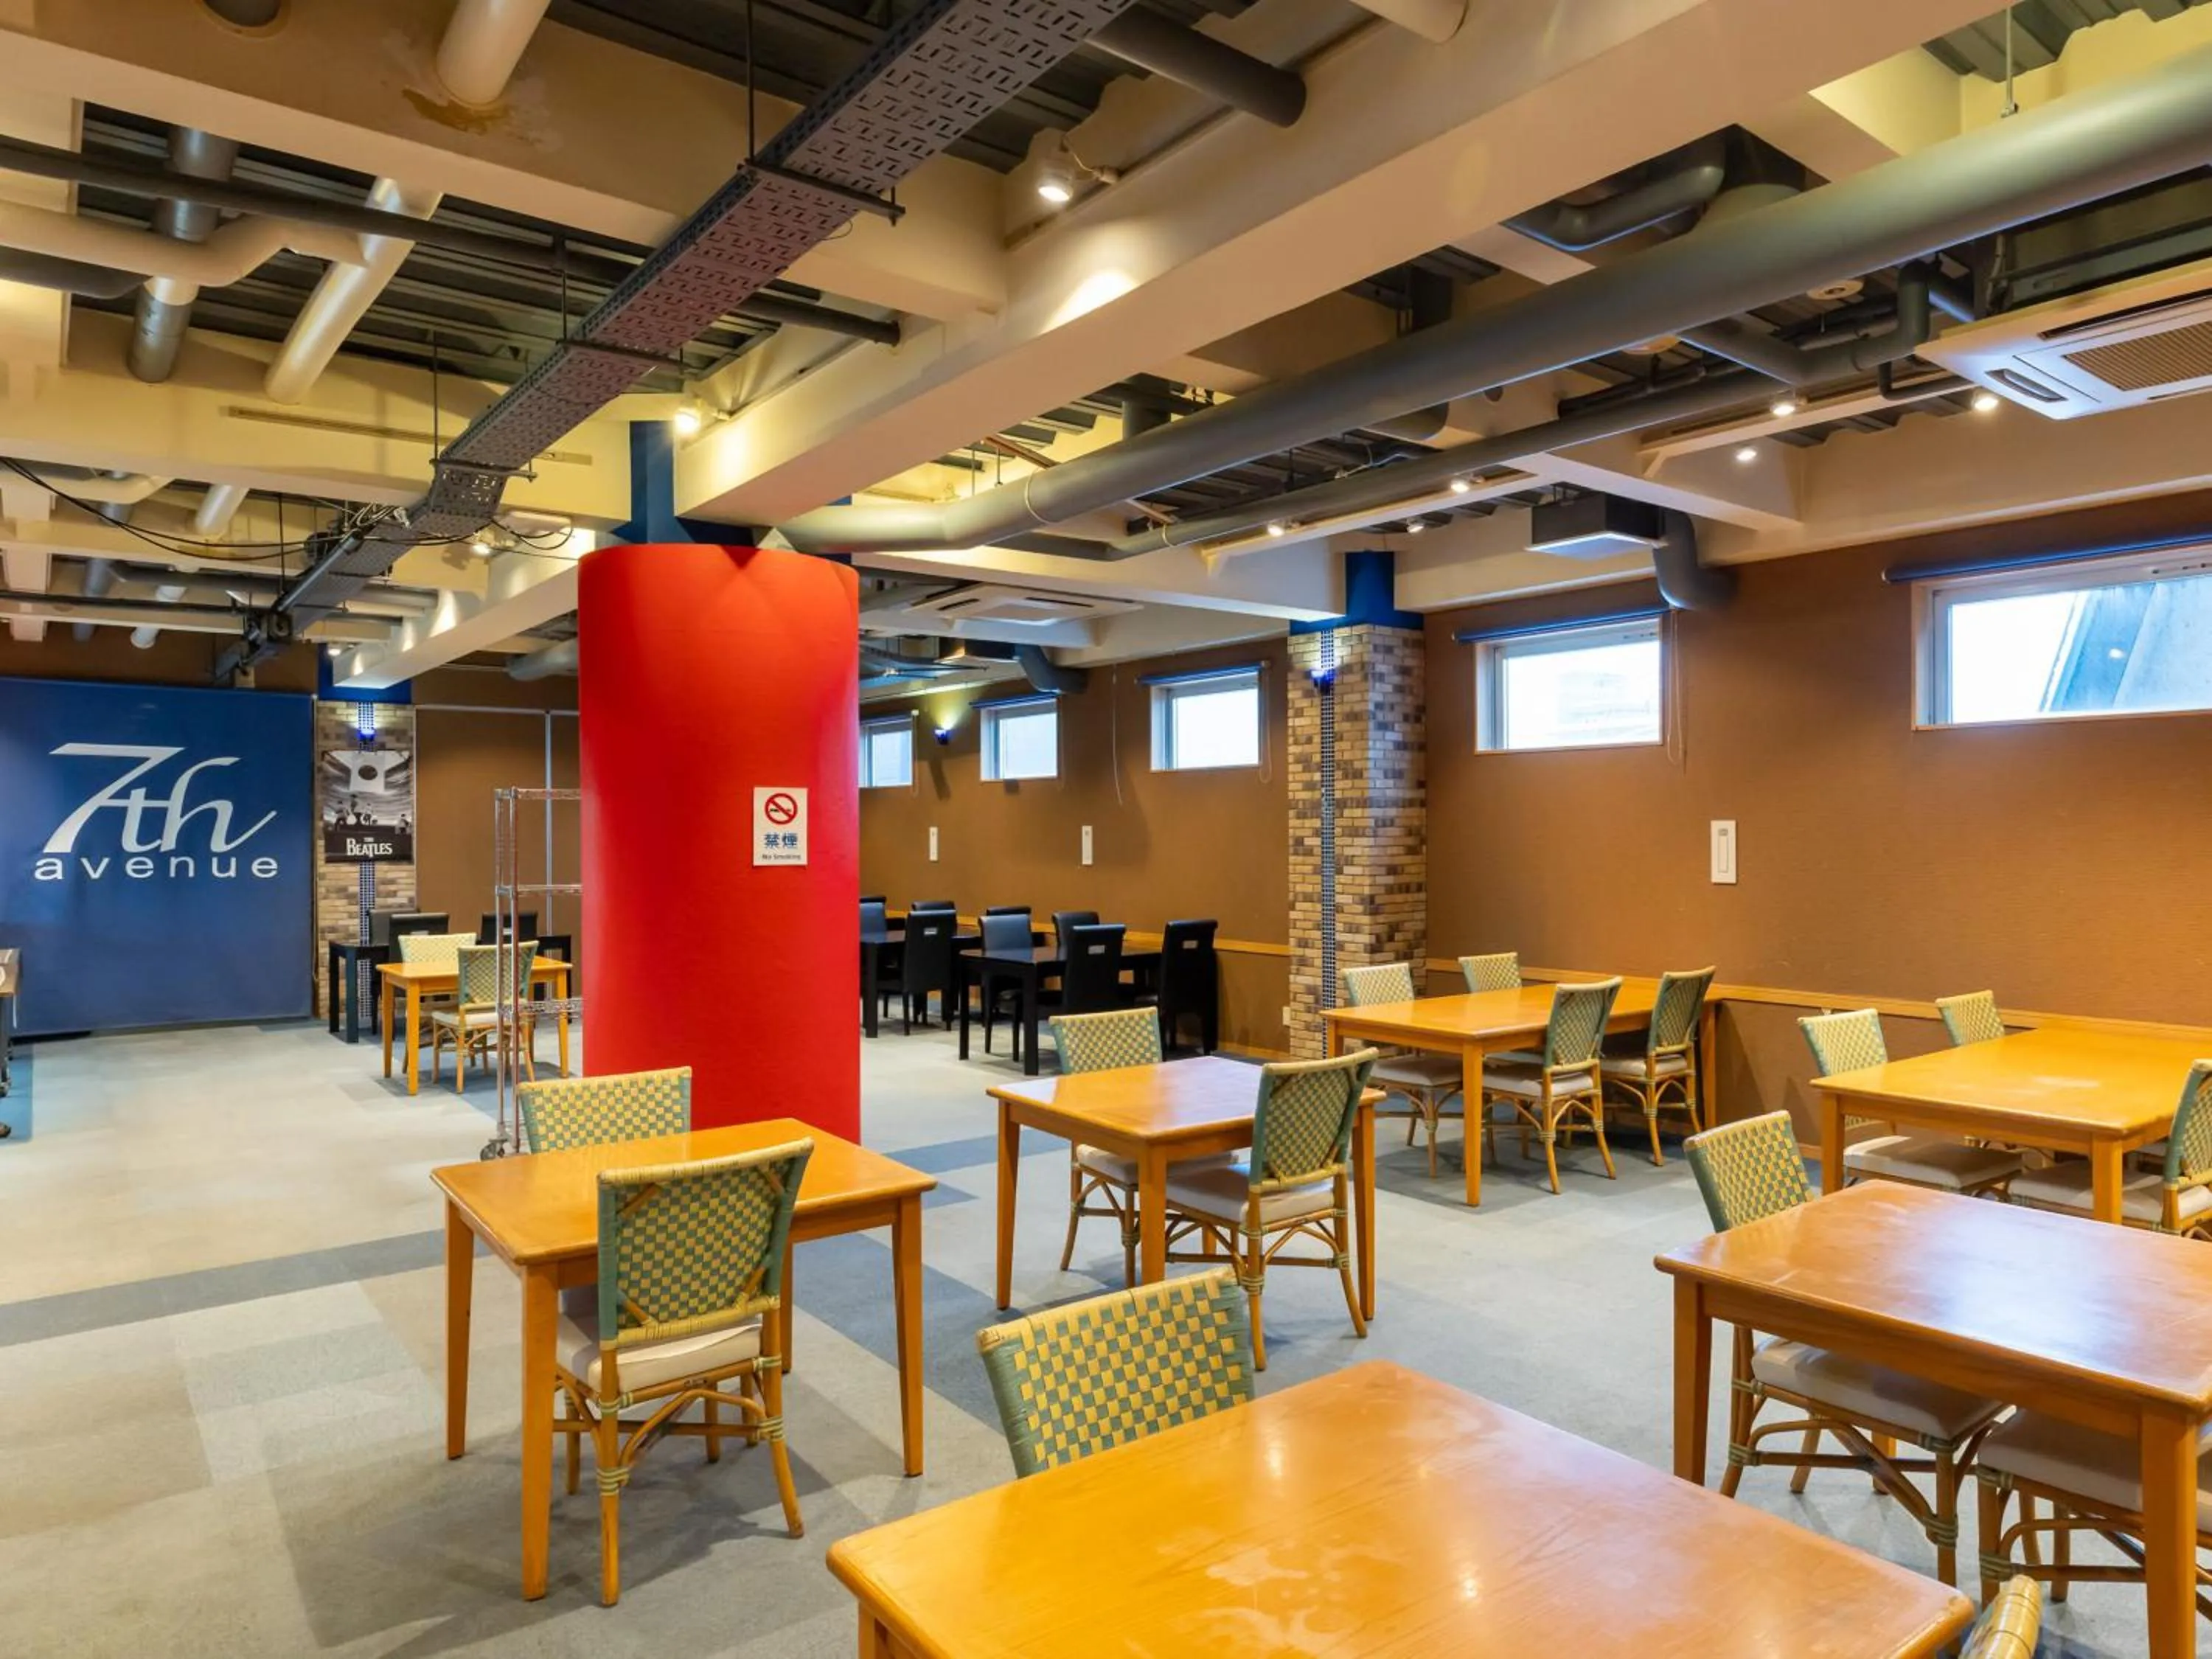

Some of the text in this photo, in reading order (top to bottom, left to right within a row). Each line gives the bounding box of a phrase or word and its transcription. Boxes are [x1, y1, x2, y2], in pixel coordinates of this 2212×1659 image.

[43, 742, 277, 853] 7th
[346, 838, 393, 857] BEATLES
[764, 832, 798, 849] 禁煙
[34, 856, 279, 880] avenue
